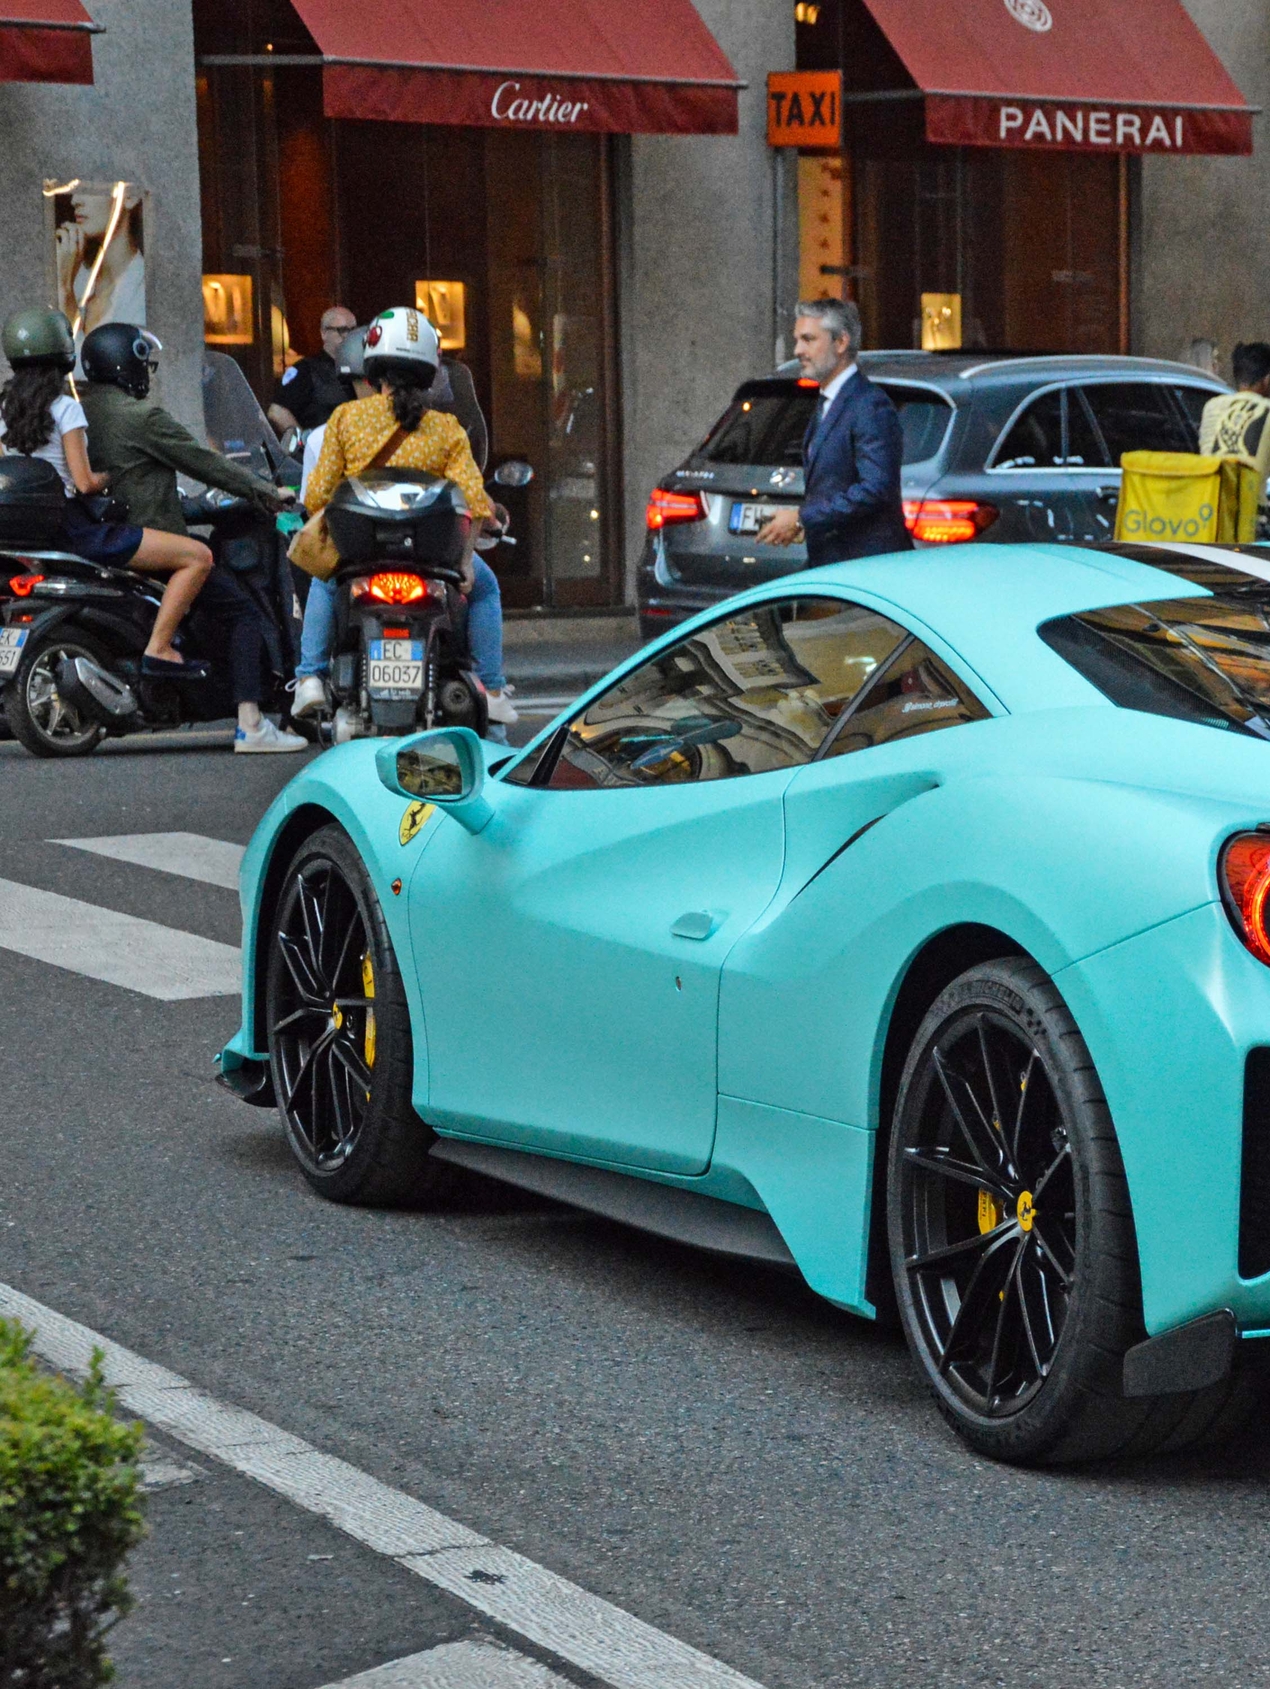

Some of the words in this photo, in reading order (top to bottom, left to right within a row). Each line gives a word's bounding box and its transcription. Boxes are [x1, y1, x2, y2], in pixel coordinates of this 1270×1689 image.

[491, 81, 588, 123] Cartier
[771, 91, 836, 127] TAXI
[1000, 106, 1182, 147] PANERAI
[1123, 508, 1200, 537] Glovo
[383, 641, 403, 660] EC
[372, 664, 421, 685] 06037
